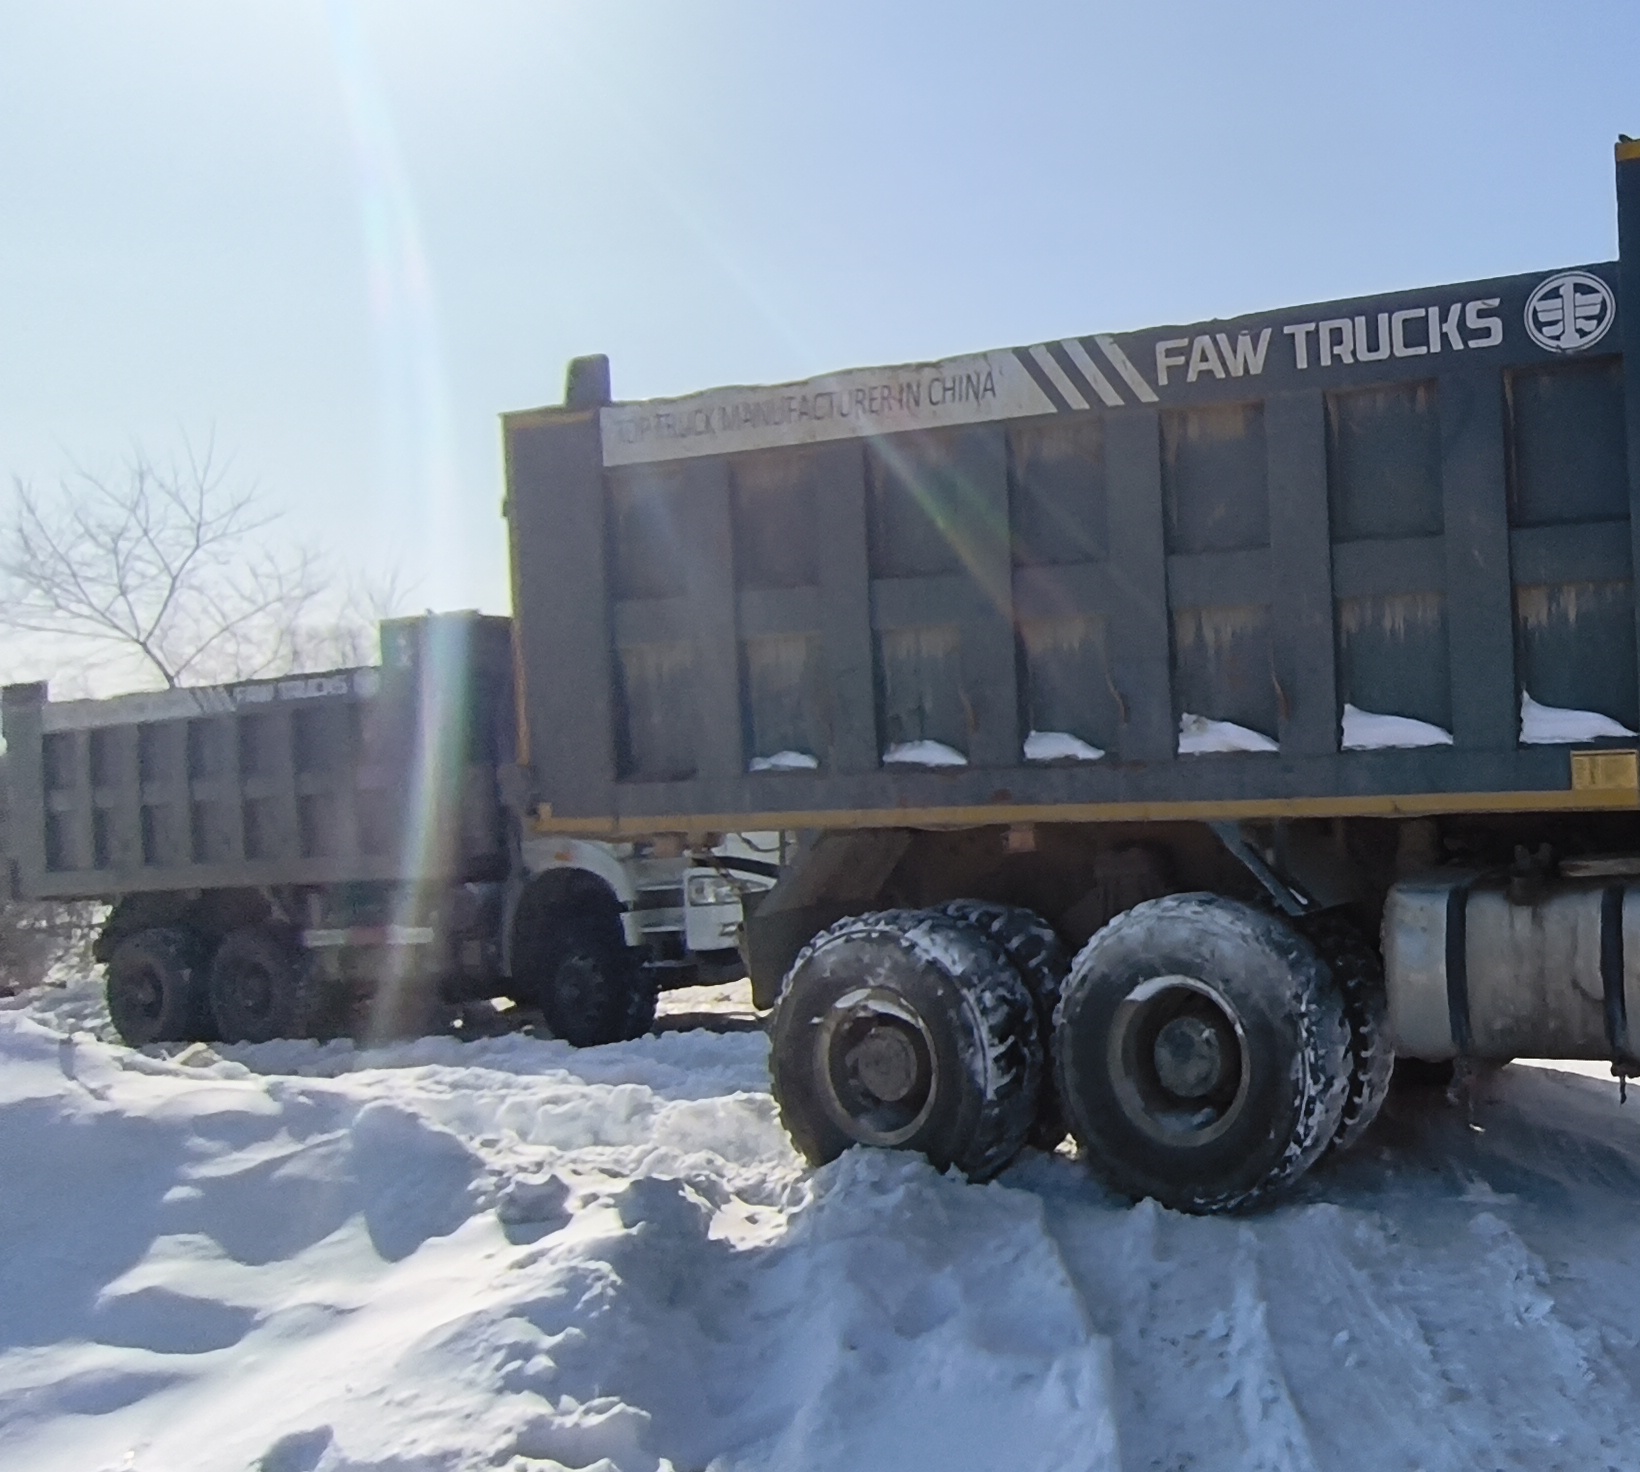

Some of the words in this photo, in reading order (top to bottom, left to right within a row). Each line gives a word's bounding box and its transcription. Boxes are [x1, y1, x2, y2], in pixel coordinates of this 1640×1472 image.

[1155, 328, 1272, 386] FAW
[1283, 298, 1503, 369] TRUCKS
[928, 371, 997, 407] CHINA
